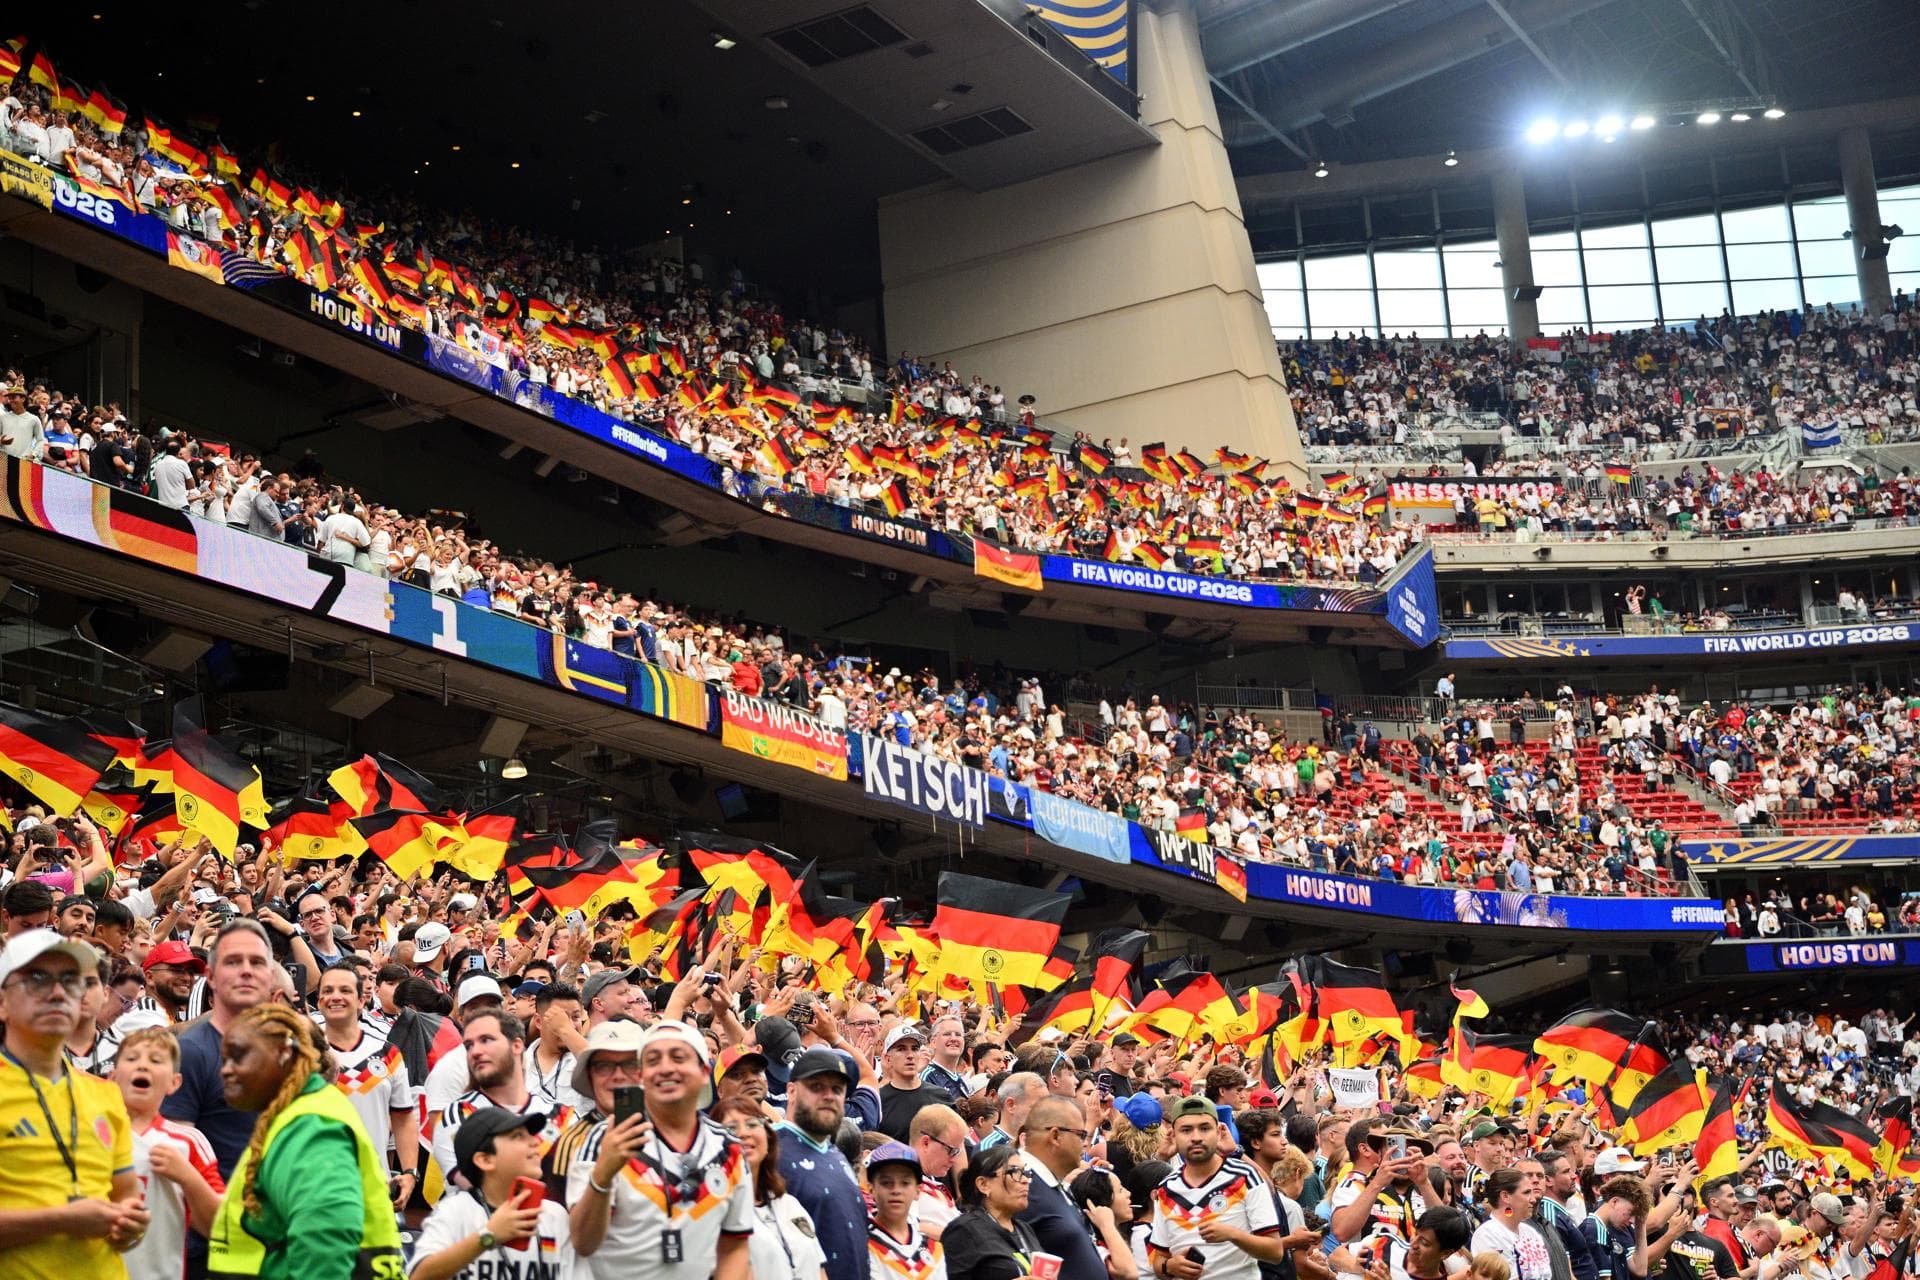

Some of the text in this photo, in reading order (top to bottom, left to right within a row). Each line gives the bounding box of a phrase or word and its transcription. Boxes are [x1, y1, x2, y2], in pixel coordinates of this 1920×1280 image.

[52, 176, 115, 225] 026
[611, 424, 668, 462] #FIFAWorldCup
[851, 513, 927, 547] HOUSTON
[1072, 562, 1253, 602] FIFA WORLD CUP 2026
[1405, 586, 1416, 606] FIFA
[307, 553, 346, 616] 7
[432, 592, 467, 657] 1
[1398, 594, 1425, 626] WORLD CUP
[1404, 614, 1423, 637] 2026
[1703, 626, 1910, 652] FIFA WORLD CUP 2026
[726, 689, 841, 749] BAD WALDSEE
[861, 733, 984, 826] KETSCH
[1155, 830, 1216, 878] MPLIN
[1286, 873, 1372, 907] HOUSTON
[1781, 943, 1896, 966] HOUSTON
